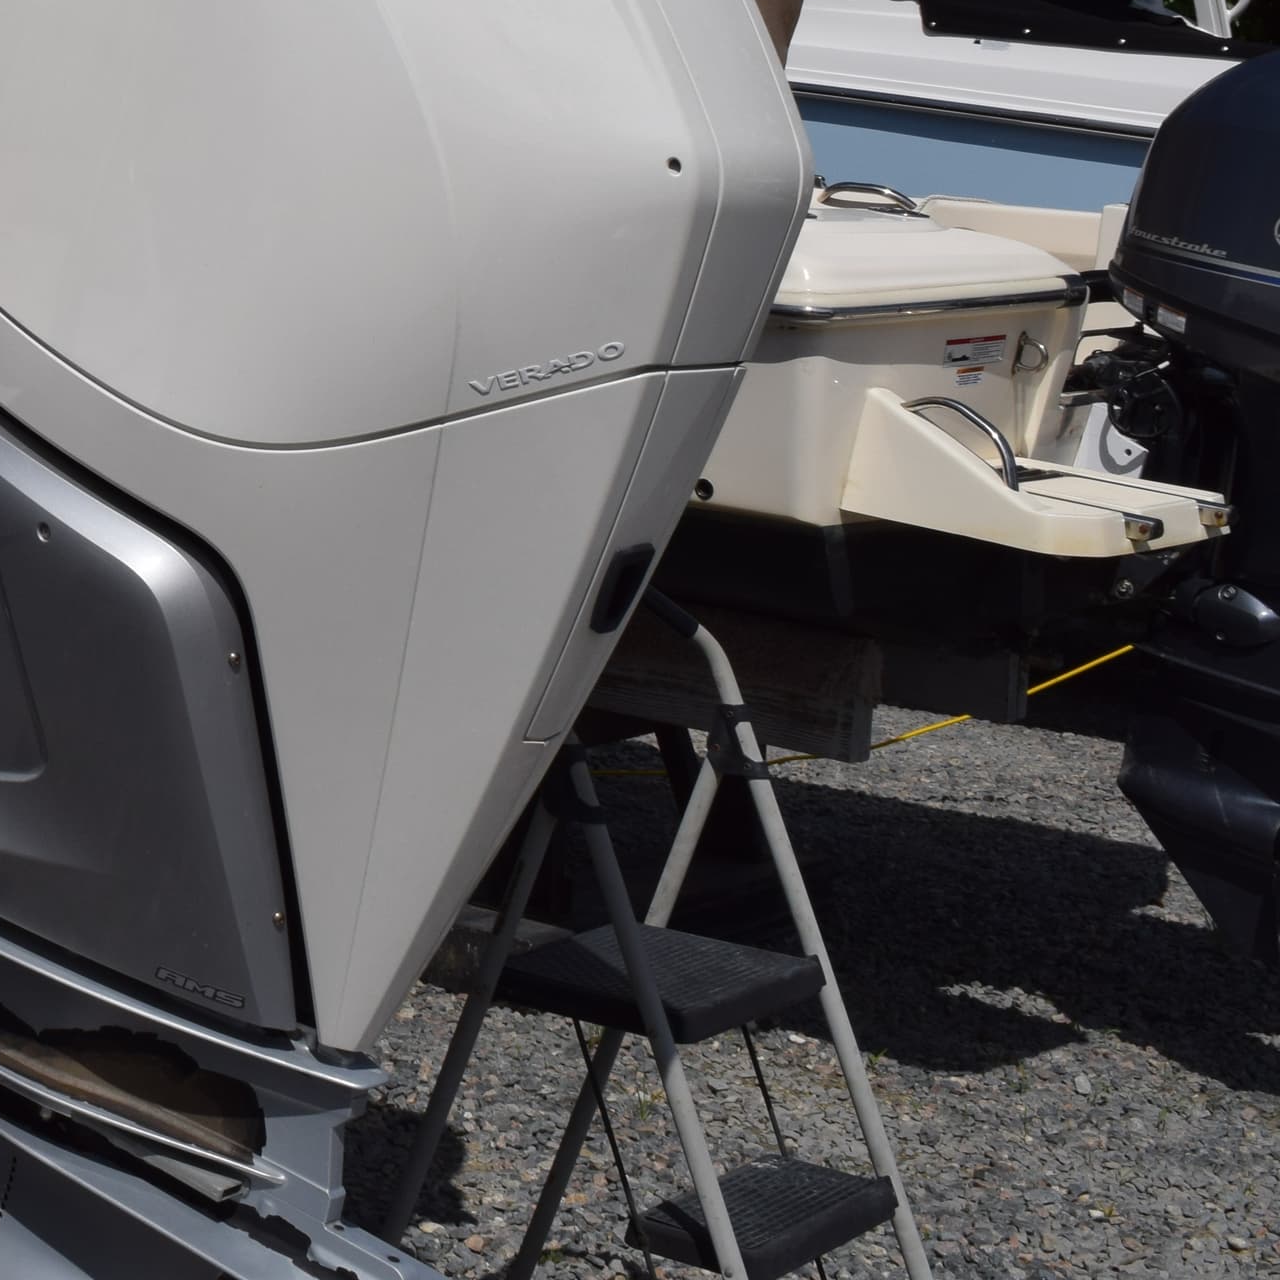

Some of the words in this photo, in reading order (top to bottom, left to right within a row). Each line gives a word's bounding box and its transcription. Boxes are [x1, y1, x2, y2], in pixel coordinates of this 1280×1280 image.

[1129, 225, 1228, 259] fourstroke
[467, 341, 626, 396] VERADO
[155, 966, 245, 1009] AMS
